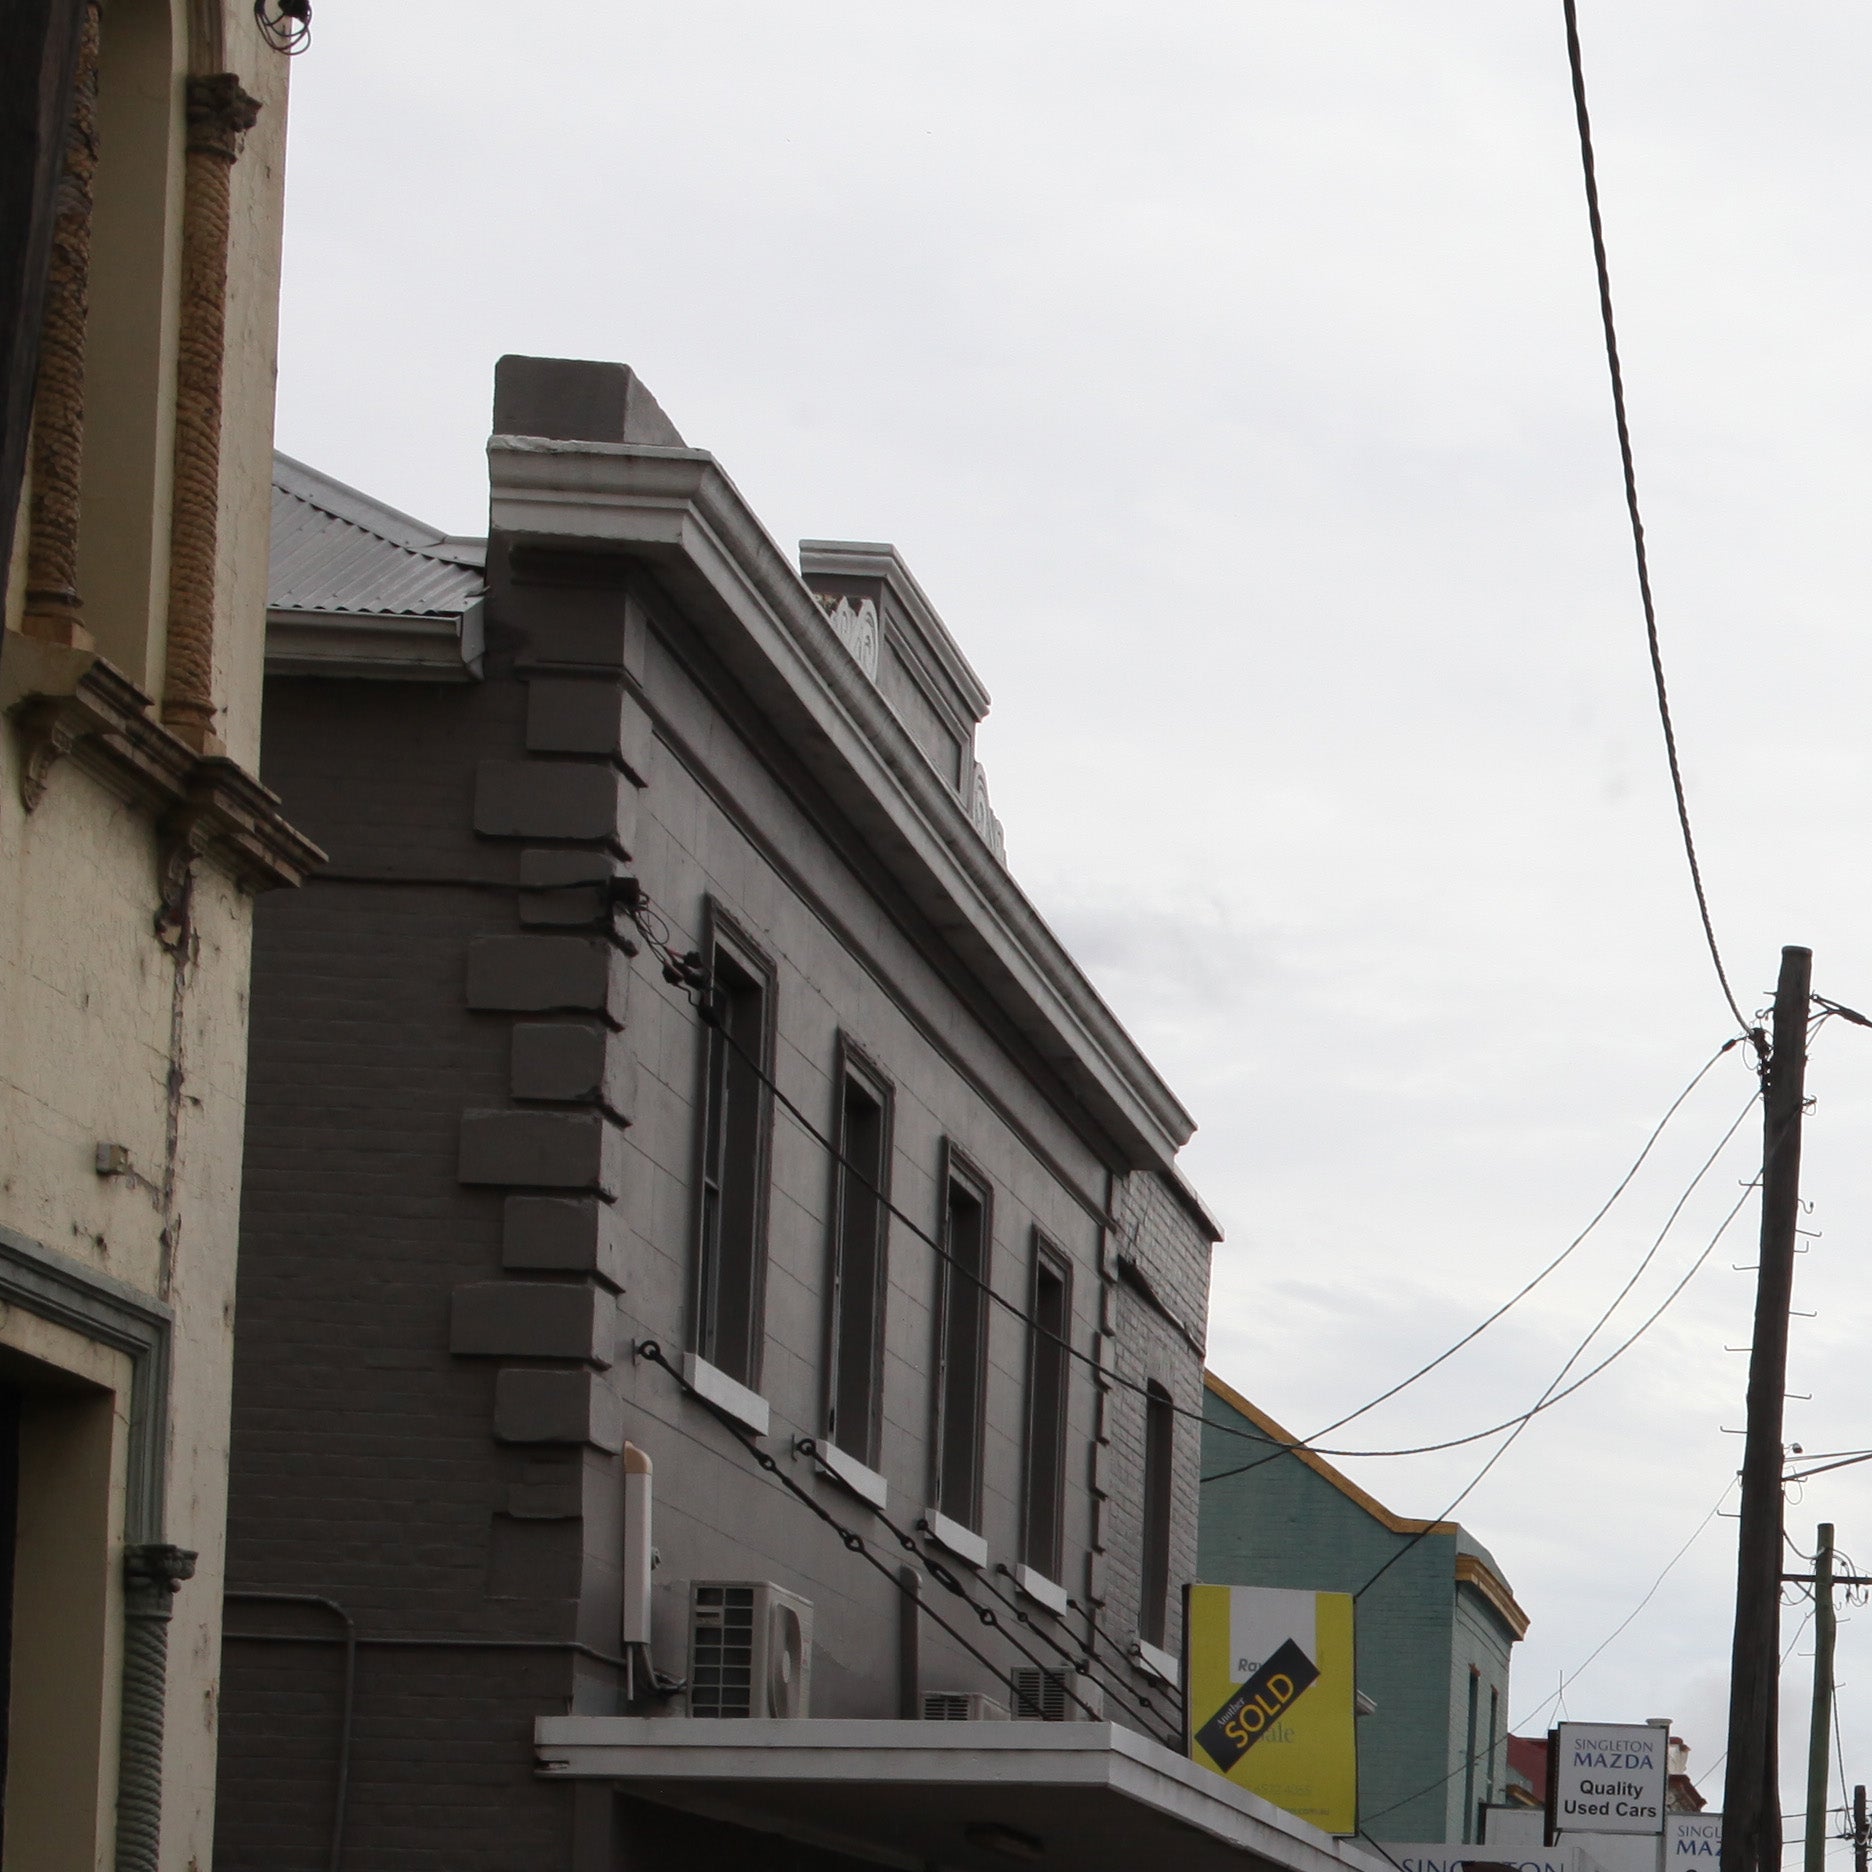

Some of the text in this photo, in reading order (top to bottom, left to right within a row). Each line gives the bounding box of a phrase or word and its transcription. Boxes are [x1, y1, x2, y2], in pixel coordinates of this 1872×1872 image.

[1224, 1673, 1296, 1749] SOLD
[1574, 1739, 1653, 1752] SINGLETON
[1574, 1752, 1654, 1770] MAZDA
[1580, 1779, 1644, 1800] Quality
[1564, 1800, 1657, 1818] Used Cars
